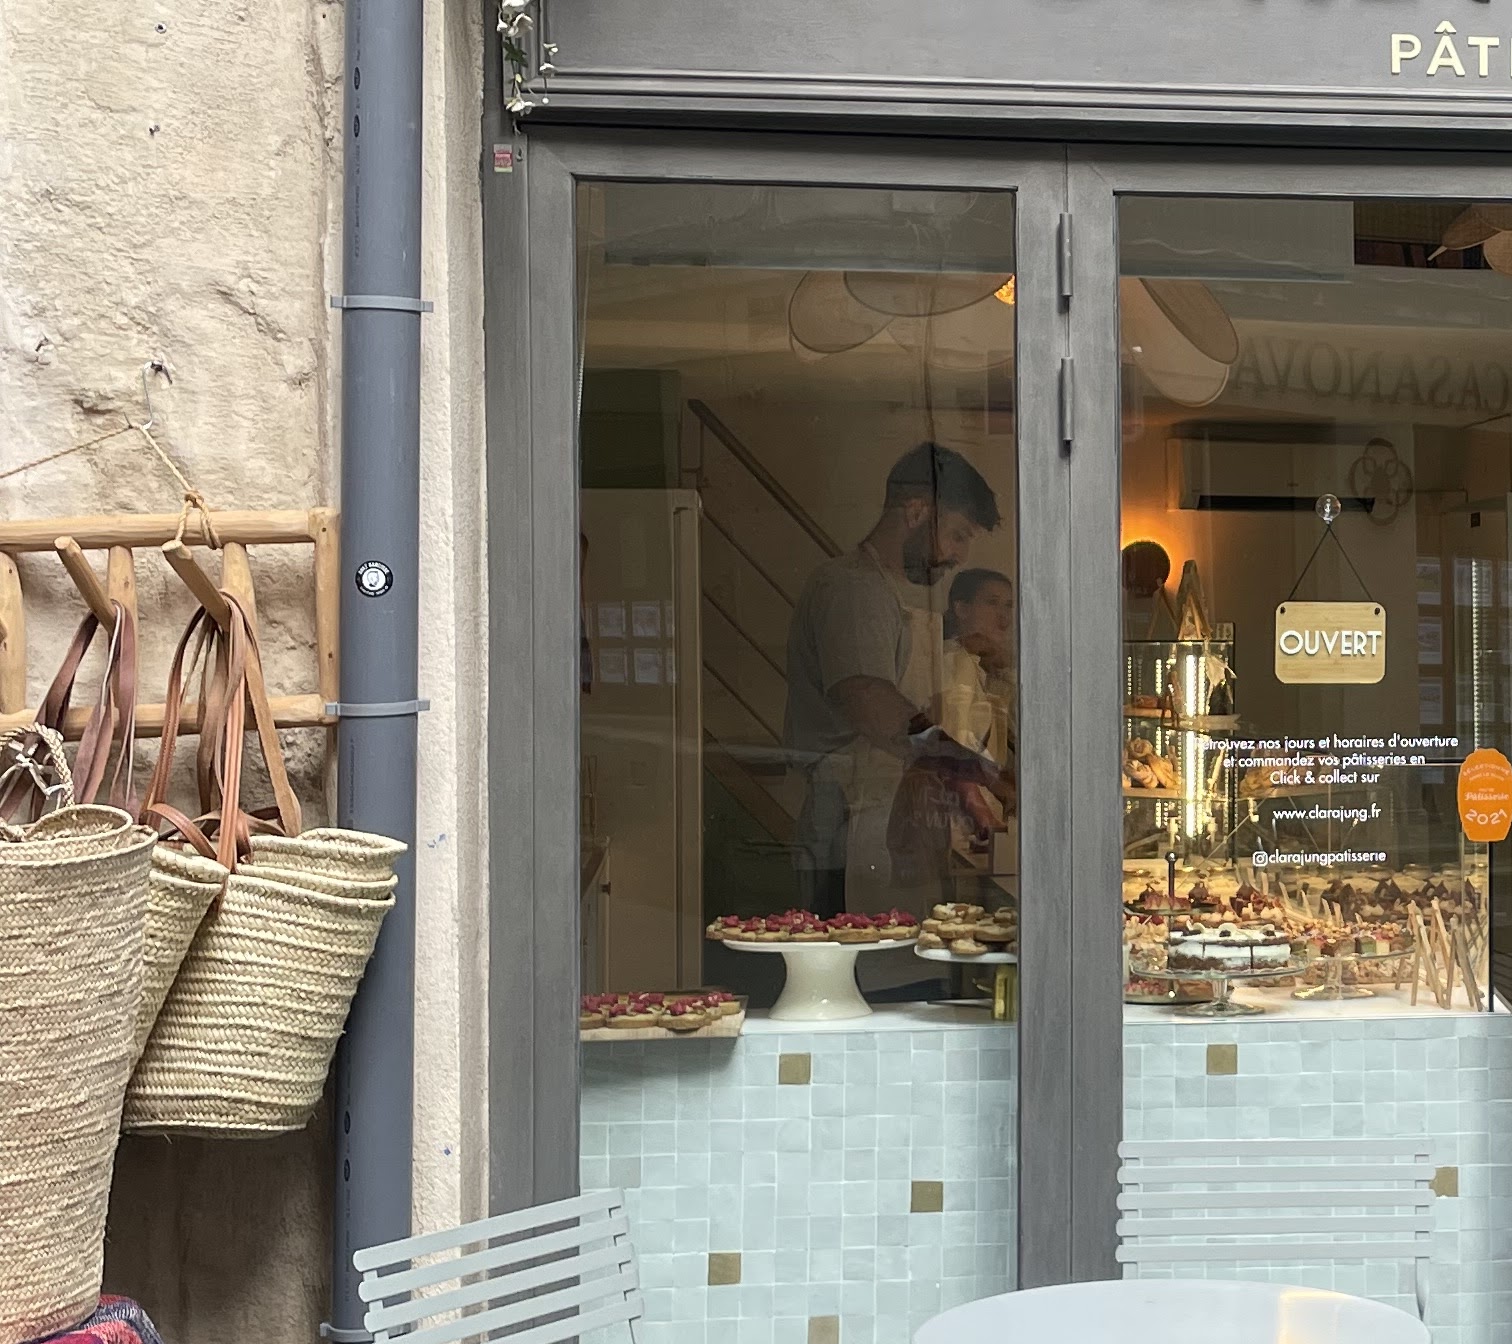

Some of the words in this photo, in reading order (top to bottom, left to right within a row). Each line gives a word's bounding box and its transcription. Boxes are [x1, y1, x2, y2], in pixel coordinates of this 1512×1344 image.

[1279, 629, 1383, 657] OUVERT
[1259, 739, 1281, 750] nos
[1284, 736, 1315, 753] jours
[1318, 736, 1331, 748] et
[1333, 734, 1385, 748] horaires
[1388, 733, 1459, 748] d'ouverture
[1223, 756, 1235, 768] et
[1239, 752, 1315, 768] commandez
[1318, 756, 1341, 766] vos
[1342, 752, 1407, 769] pâtisseries
[1410, 755, 1426, 765] en
[1269, 769, 1301, 784] Click
[1304, 770, 1316, 784] &
[1319, 769, 1358, 784] collect
[1361, 772, 1381, 783] sur
[1273, 803, 1382, 822] www.clarajung.fr
[1465, 808, 1508, 825] 2021
[1268, 848, 1387, 866] clarajungpatisserie
